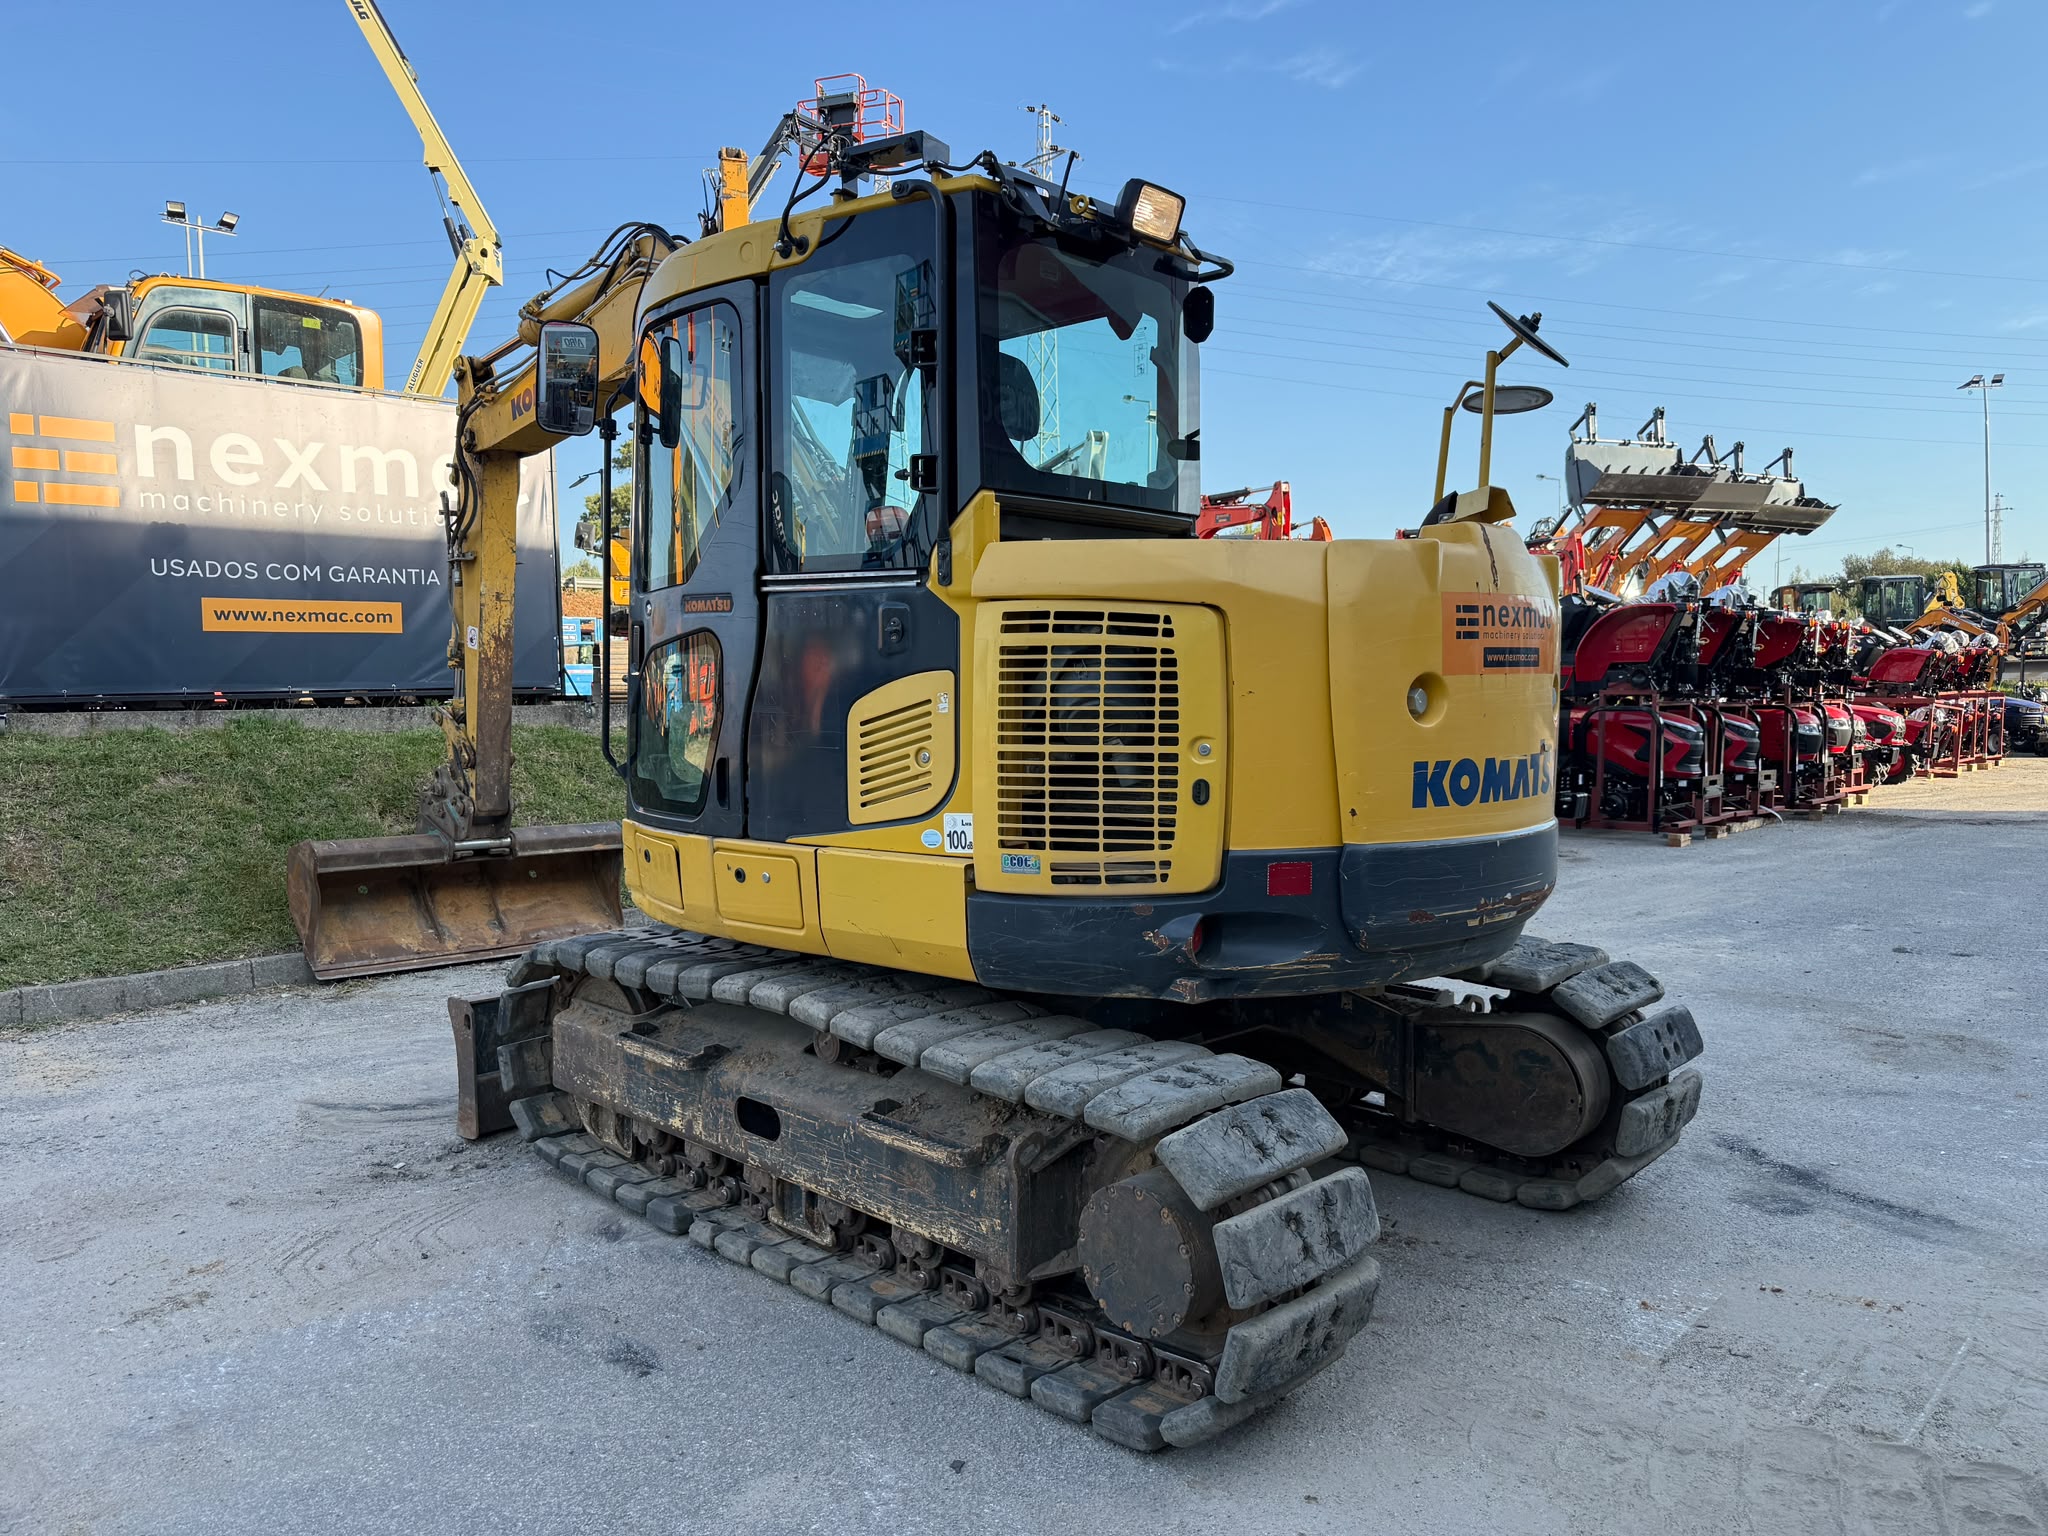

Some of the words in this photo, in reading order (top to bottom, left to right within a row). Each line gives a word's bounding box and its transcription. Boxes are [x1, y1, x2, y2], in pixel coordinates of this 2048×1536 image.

[408, 358, 424, 391] ALUGUER
[139, 488, 324, 524] machinery
[339, 503, 446, 528] solutio
[150, 558, 258, 581] USADOS
[265, 563, 321, 583] COM
[329, 566, 441, 586] GARANTIA
[685, 597, 730, 612] KOMATSU
[213, 606, 393, 625] www.nexmac.com
[1941, 617, 1960, 627] CASE
[1483, 631, 1520, 640] machinery
[947, 830, 967, 850] 100
